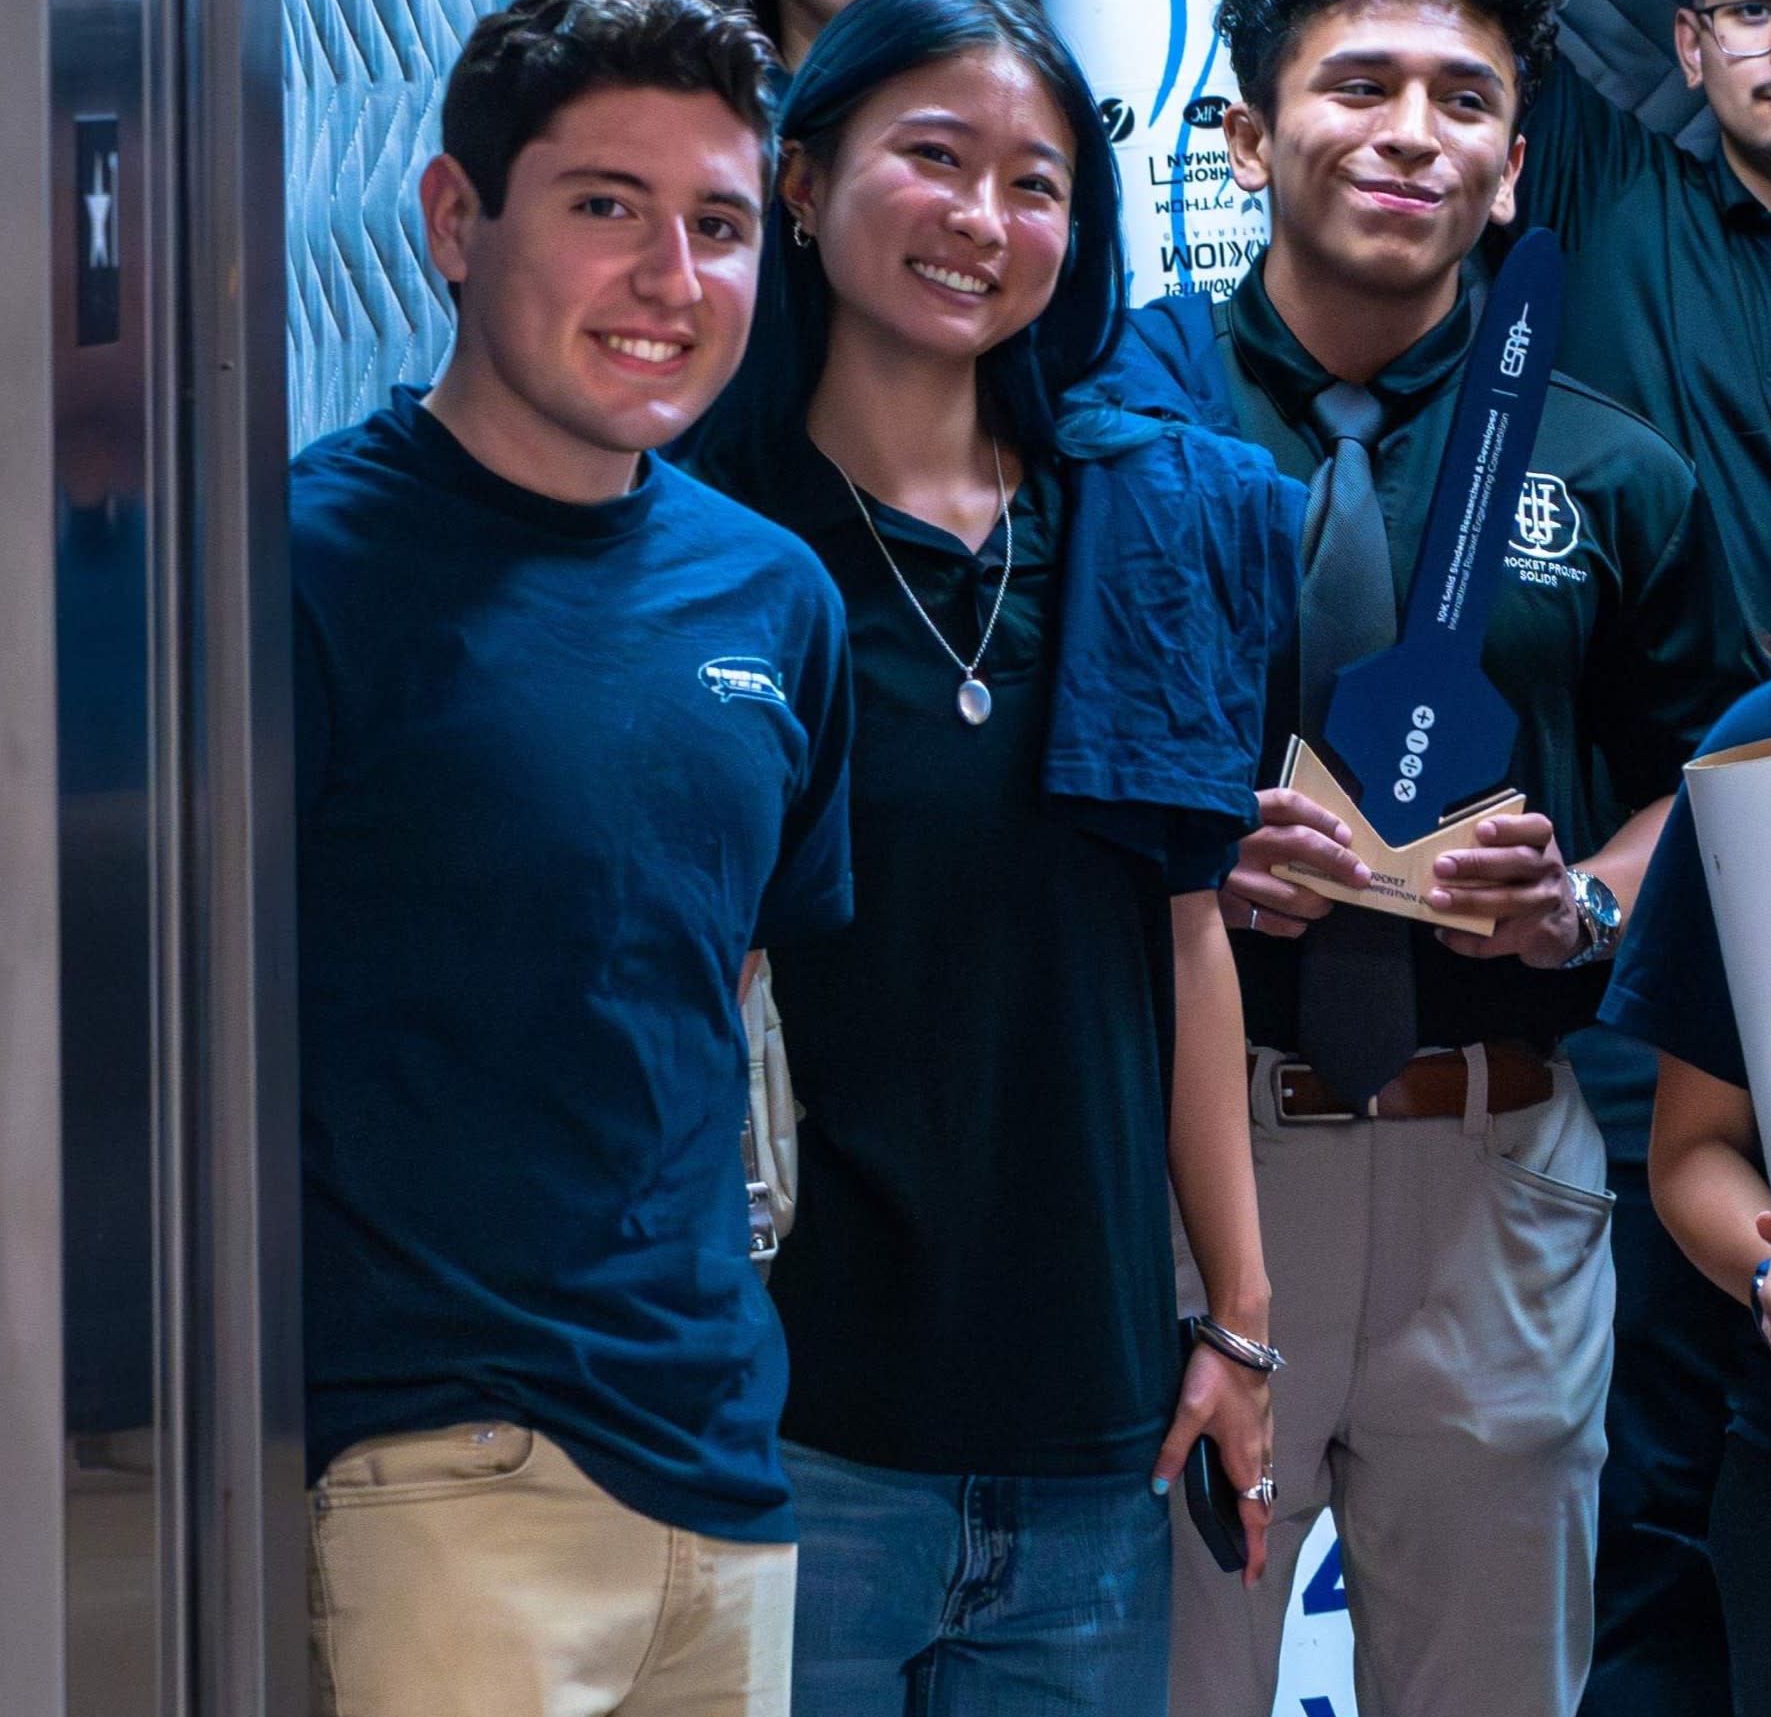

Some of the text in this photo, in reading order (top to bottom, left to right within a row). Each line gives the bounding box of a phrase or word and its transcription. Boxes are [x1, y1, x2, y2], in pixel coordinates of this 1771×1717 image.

[1155, 196, 1234, 214] PYTHOM
[1442, 575, 1456, 602] Solid
[1449, 534, 1467, 574] Student
[1460, 473, 1481, 534] Researched
[1477, 408, 1498, 464] Developed
[1447, 412, 1510, 631] International Rocket Engineering Competition
[1519, 569, 1559, 588] SOLIDS
[1548, 563, 1589, 584] PROJECT
